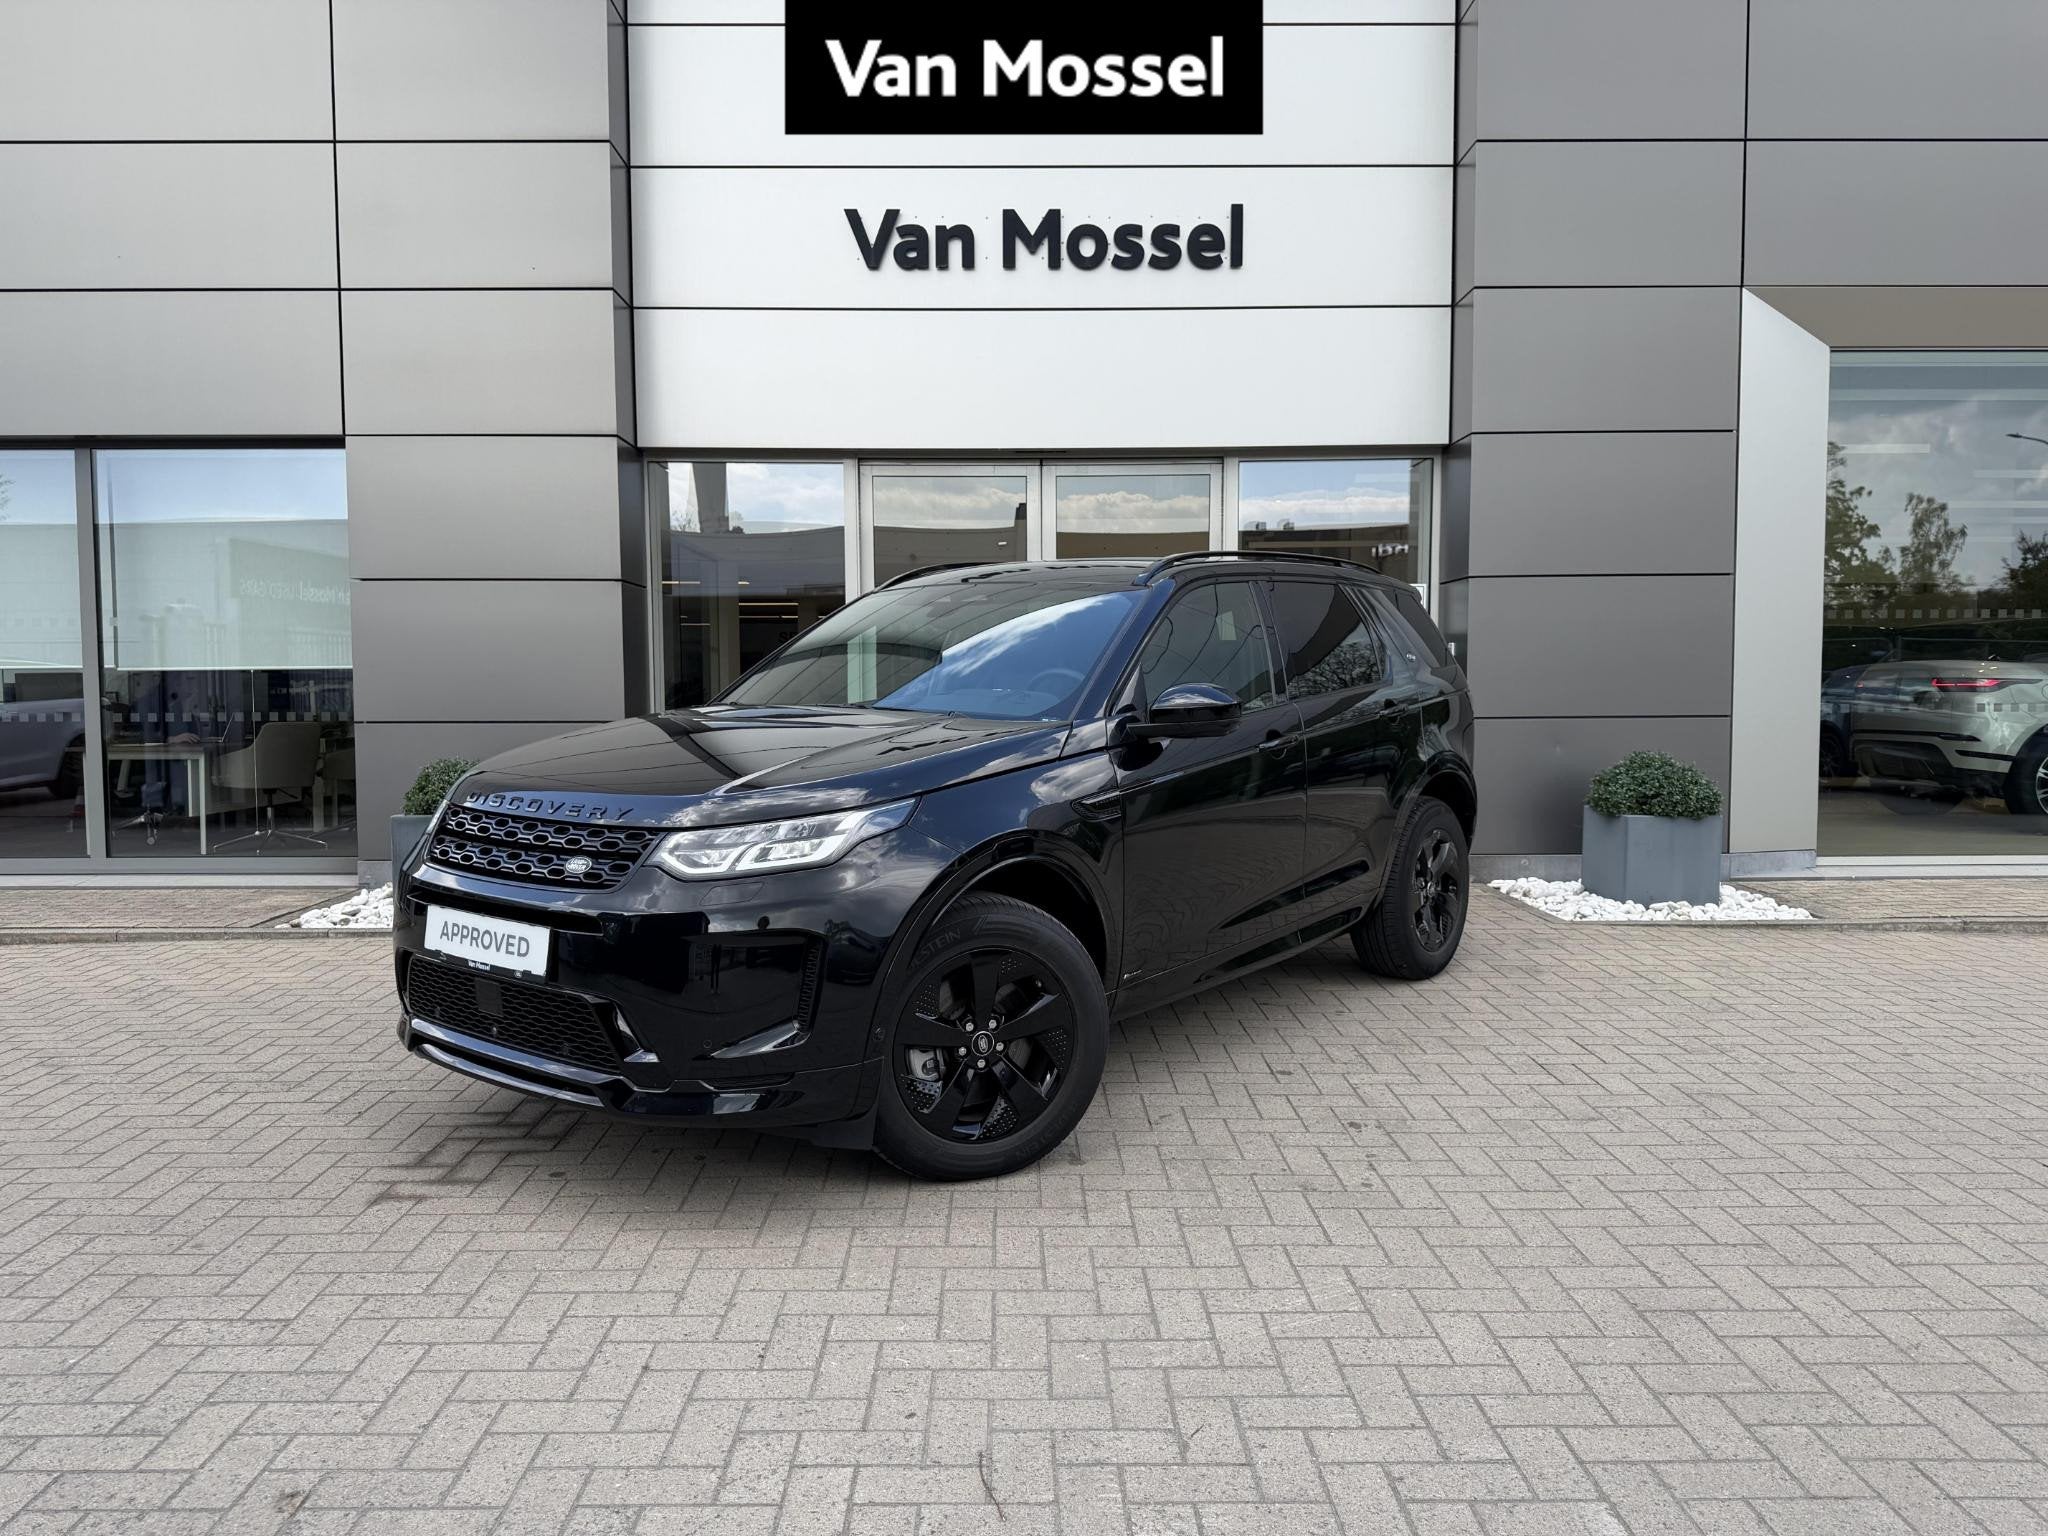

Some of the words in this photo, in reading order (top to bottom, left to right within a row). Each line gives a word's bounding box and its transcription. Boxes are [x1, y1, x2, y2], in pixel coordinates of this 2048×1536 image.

[843, 208, 975, 271] Van
[1002, 203, 1244, 271] Mossel
[466, 791, 635, 820] DISCOVERY
[440, 920, 530, 957] APPROVED
